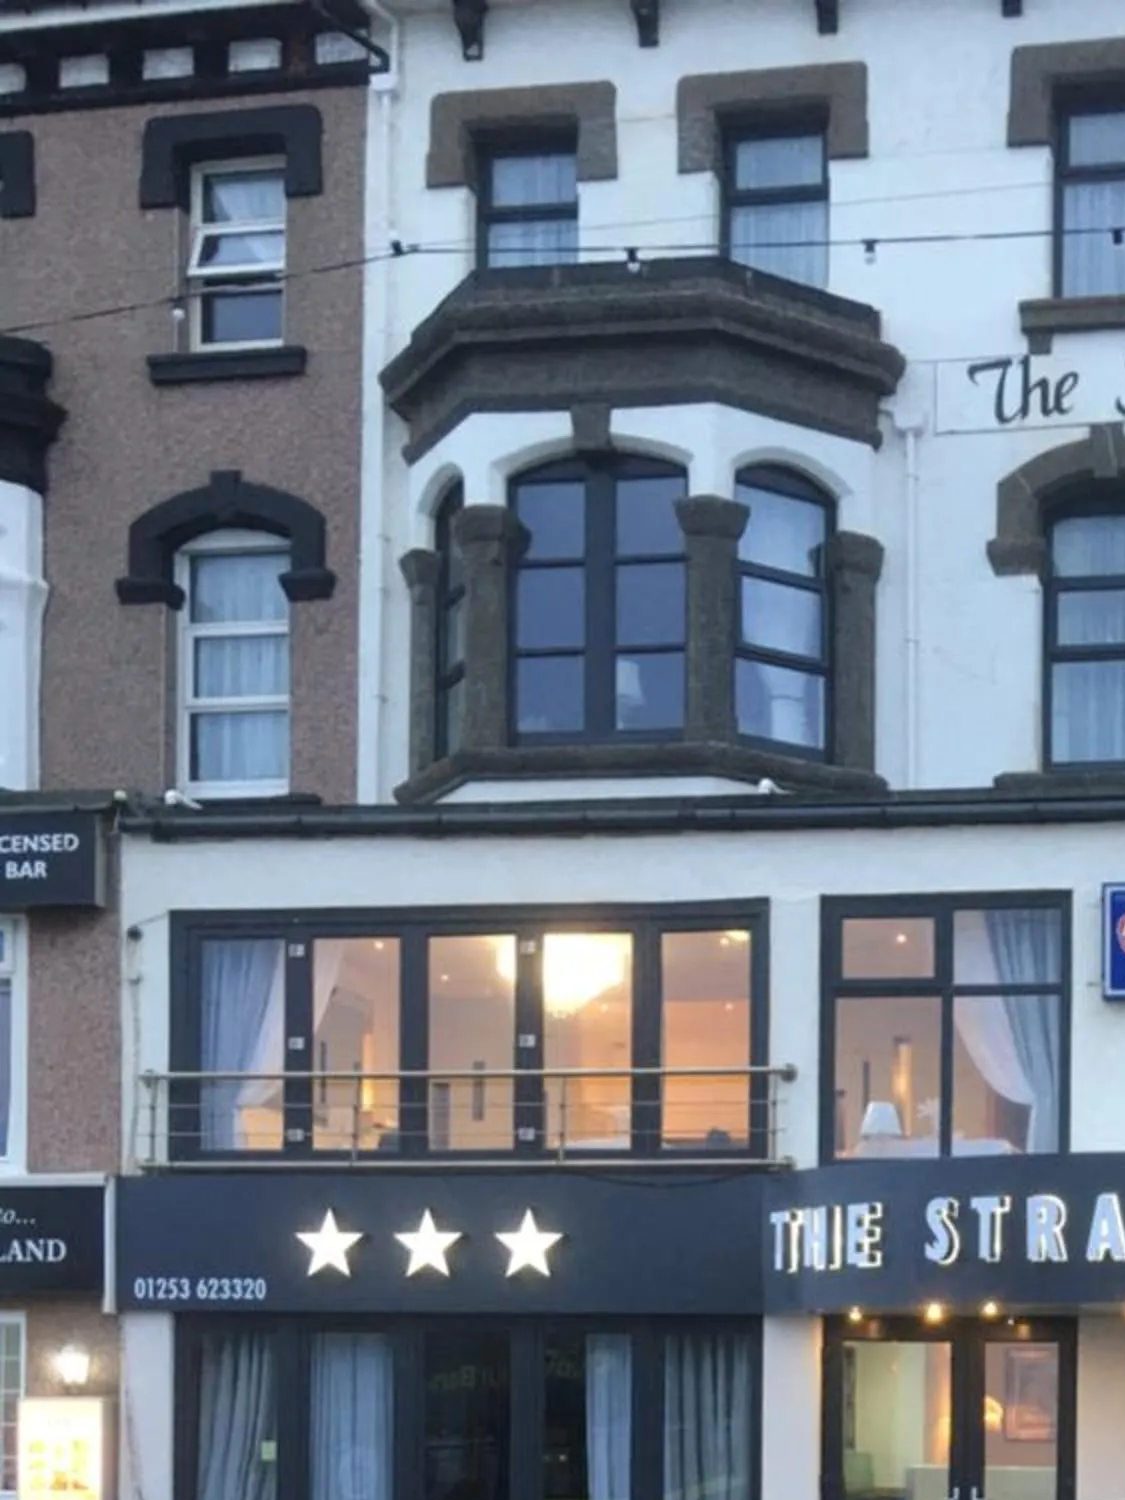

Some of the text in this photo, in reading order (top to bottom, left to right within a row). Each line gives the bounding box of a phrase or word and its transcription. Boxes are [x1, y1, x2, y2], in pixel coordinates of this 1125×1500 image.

[968, 354, 1079, 424] The
[0, 833, 80, 853] CENSED
[5, 860, 48, 879] BAR
[770, 1201, 885, 1273] THE
[133, 1277, 267, 1300] 01253 623320
